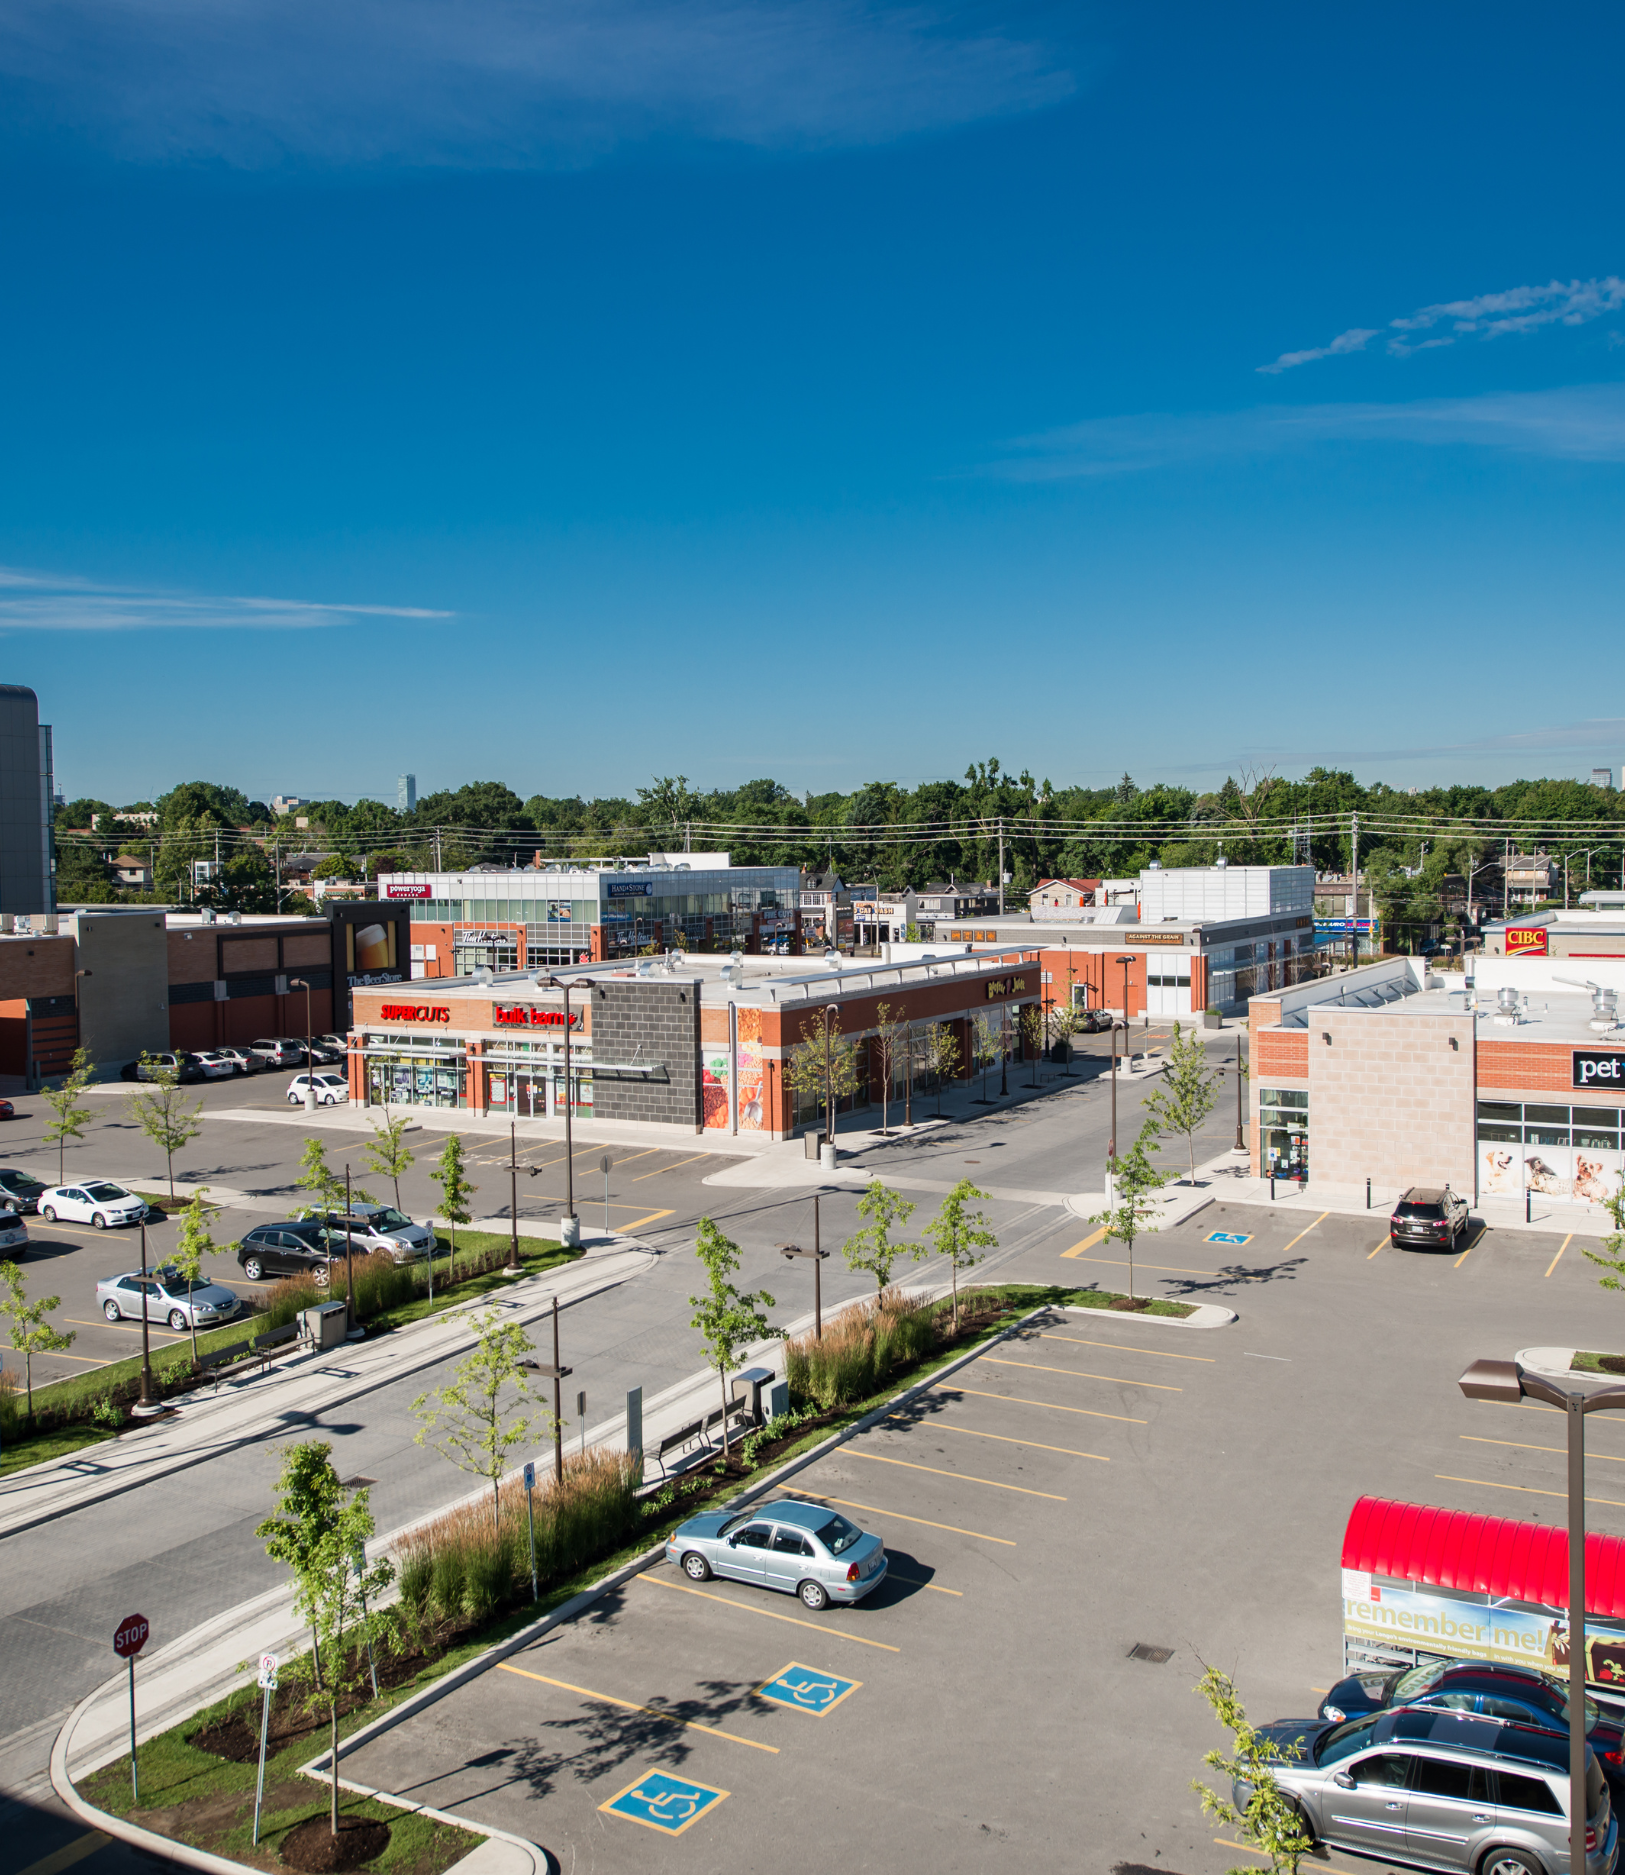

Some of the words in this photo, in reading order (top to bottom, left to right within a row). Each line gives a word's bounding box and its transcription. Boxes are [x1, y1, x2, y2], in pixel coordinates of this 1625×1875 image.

[389, 885, 426, 894] poweryoga
[777, 909, 793, 918] GUYS
[628, 930, 650, 942] Hotons
[1508, 931, 1544, 944] CIBC
[381, 1004, 450, 1022] SUPERCUTS
[496, 1006, 528, 1023] bulk
[530, 1007, 566, 1025] barn
[1580, 1059, 1621, 1083] pet
[116, 1622, 148, 1649] STOP
[1347, 1600, 1486, 1641] remember
[1494, 1627, 1544, 1653] me!
[1347, 1624, 1361, 1634] Bring
[1362, 1628, 1374, 1636] your
[1375, 1630, 1397, 1641] Longo's
[1397, 1636, 1447, 1651] environmentally
[1447, 1644, 1471, 1656] friendly
[1471, 1648, 1487, 1658] bags
[1527, 1660, 1544, 1668] when
[1544, 1664, 1556, 1672] you
